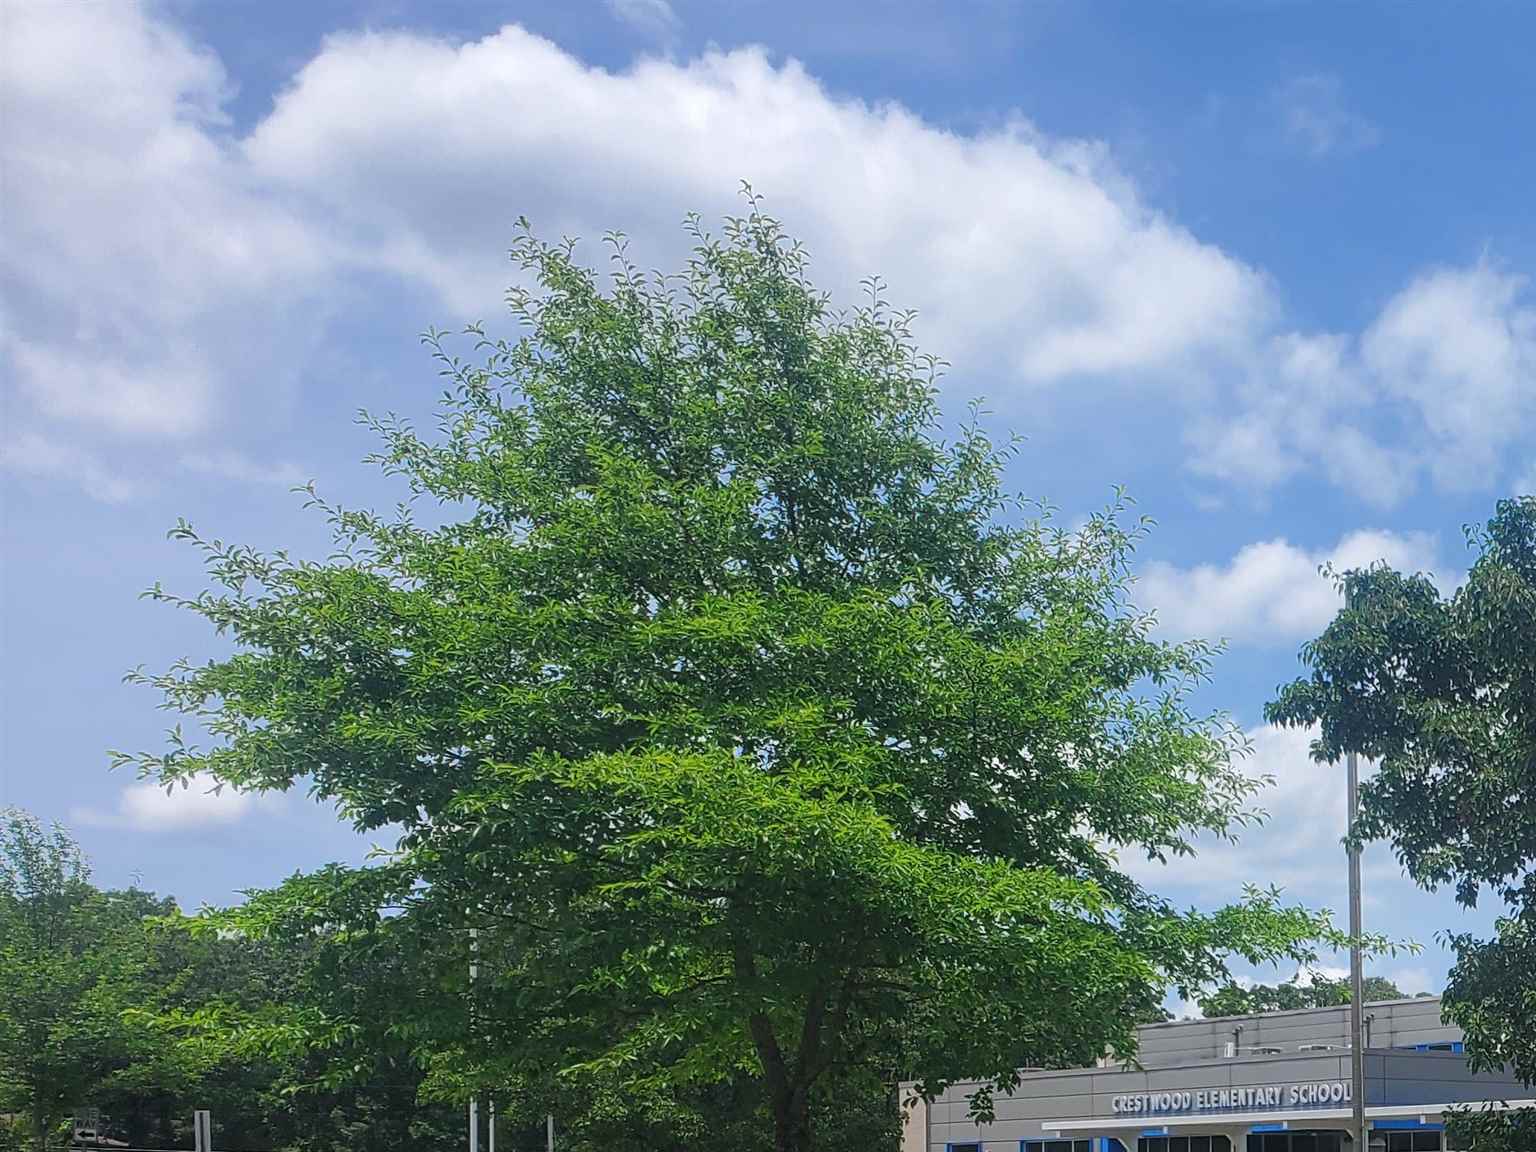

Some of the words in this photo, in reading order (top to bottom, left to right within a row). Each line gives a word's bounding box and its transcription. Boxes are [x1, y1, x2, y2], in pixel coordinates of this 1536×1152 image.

[1112, 1092, 1192, 1113] CRESTWOOD
[1196, 1087, 1282, 1109] ELEMENTARY
[1290, 1082, 1353, 1104] SCHOOL
